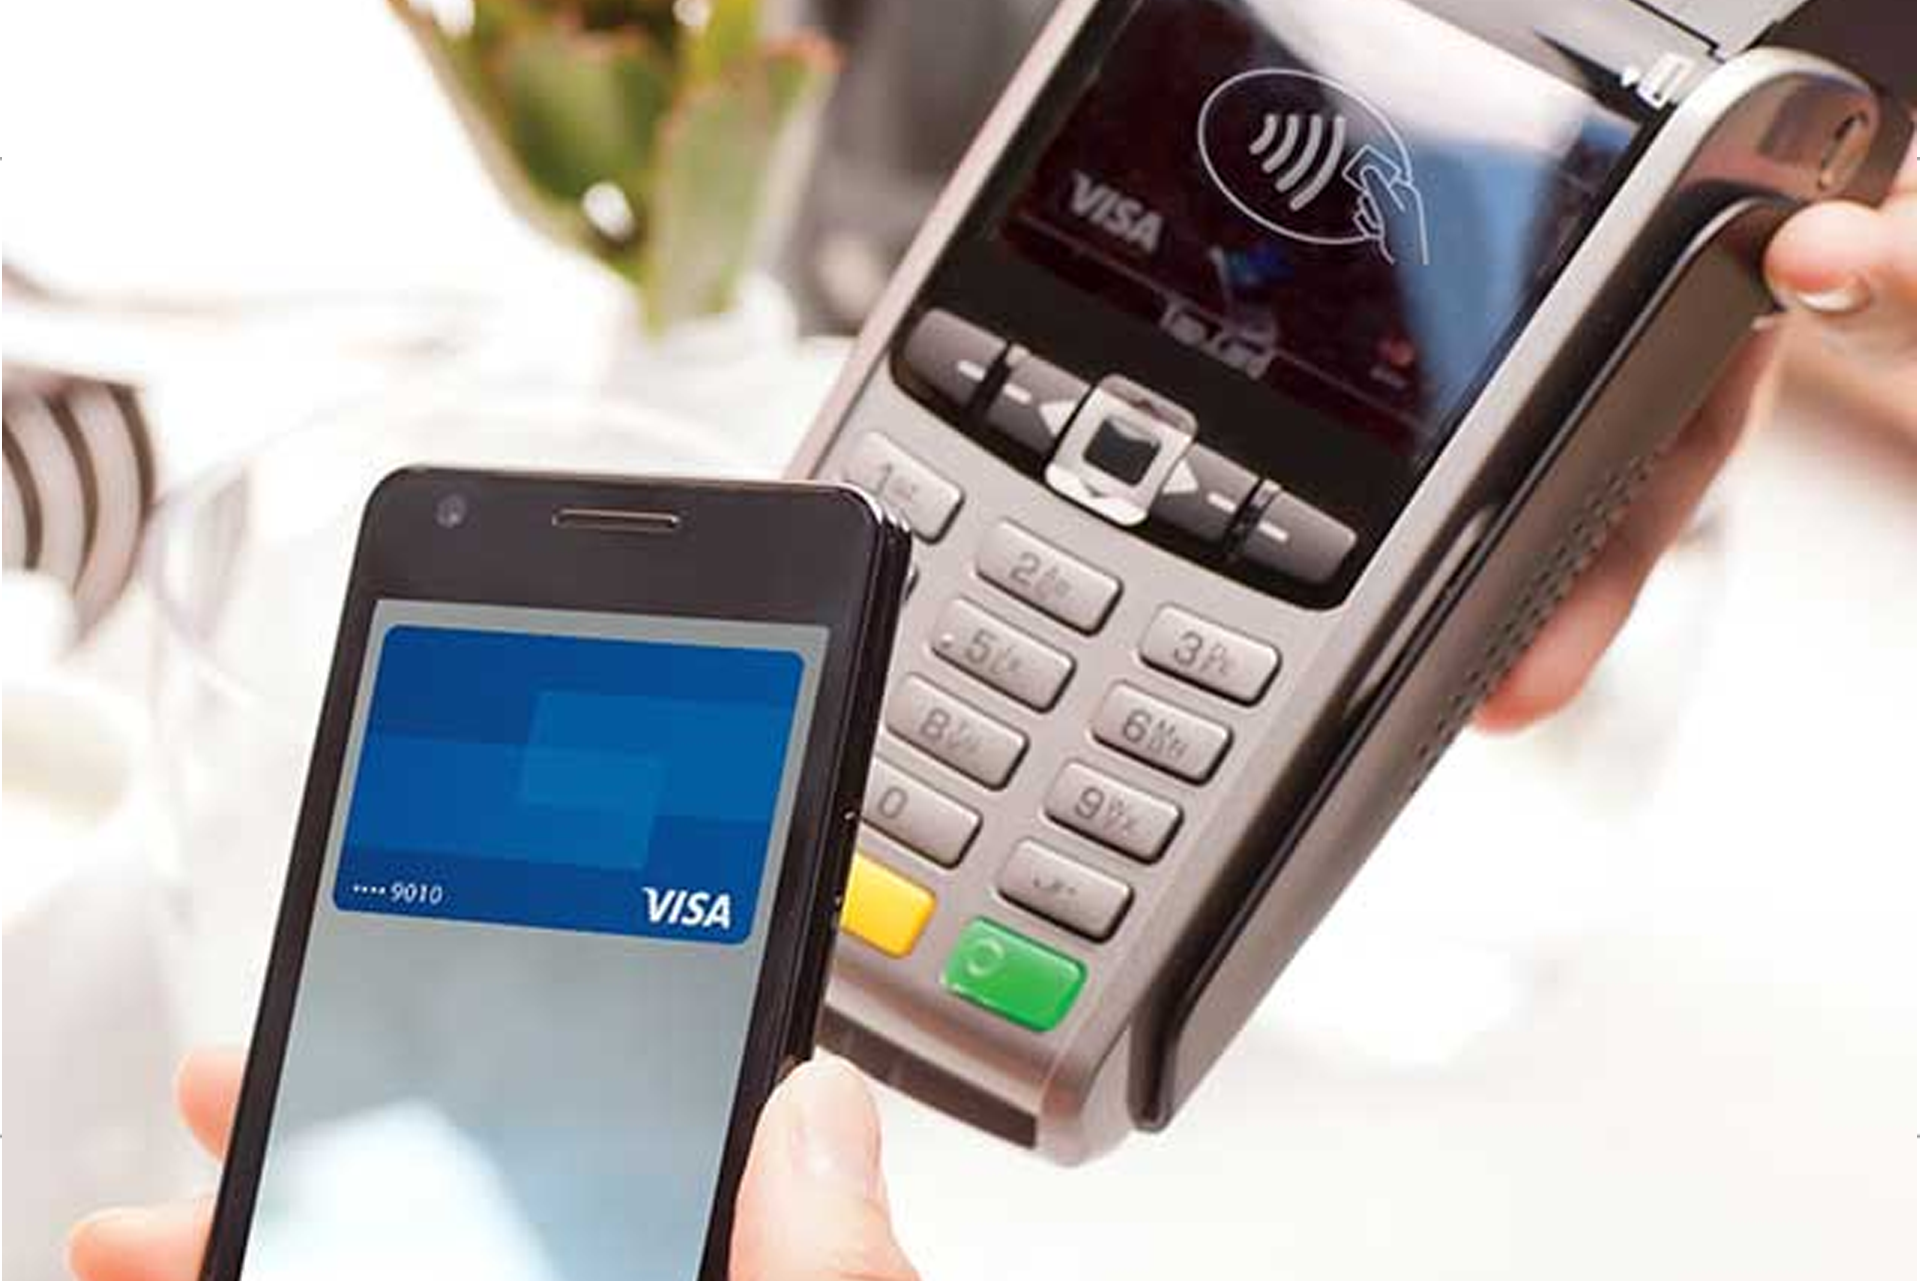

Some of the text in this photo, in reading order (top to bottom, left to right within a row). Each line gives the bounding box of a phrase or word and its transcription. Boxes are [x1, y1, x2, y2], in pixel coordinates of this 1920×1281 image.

[1068, 172, 1165, 255] VISA
[1007, 551, 1042, 588] 2
[963, 628, 998, 665] 5
[1173, 630, 1205, 667] 3
[920, 706, 952, 741] 8
[1121, 708, 1153, 744] 6
[876, 786, 909, 820] 0
[1074, 786, 1106, 820] 9
[389, 881, 444, 907] 9010
[642, 886, 732, 930] VISA
